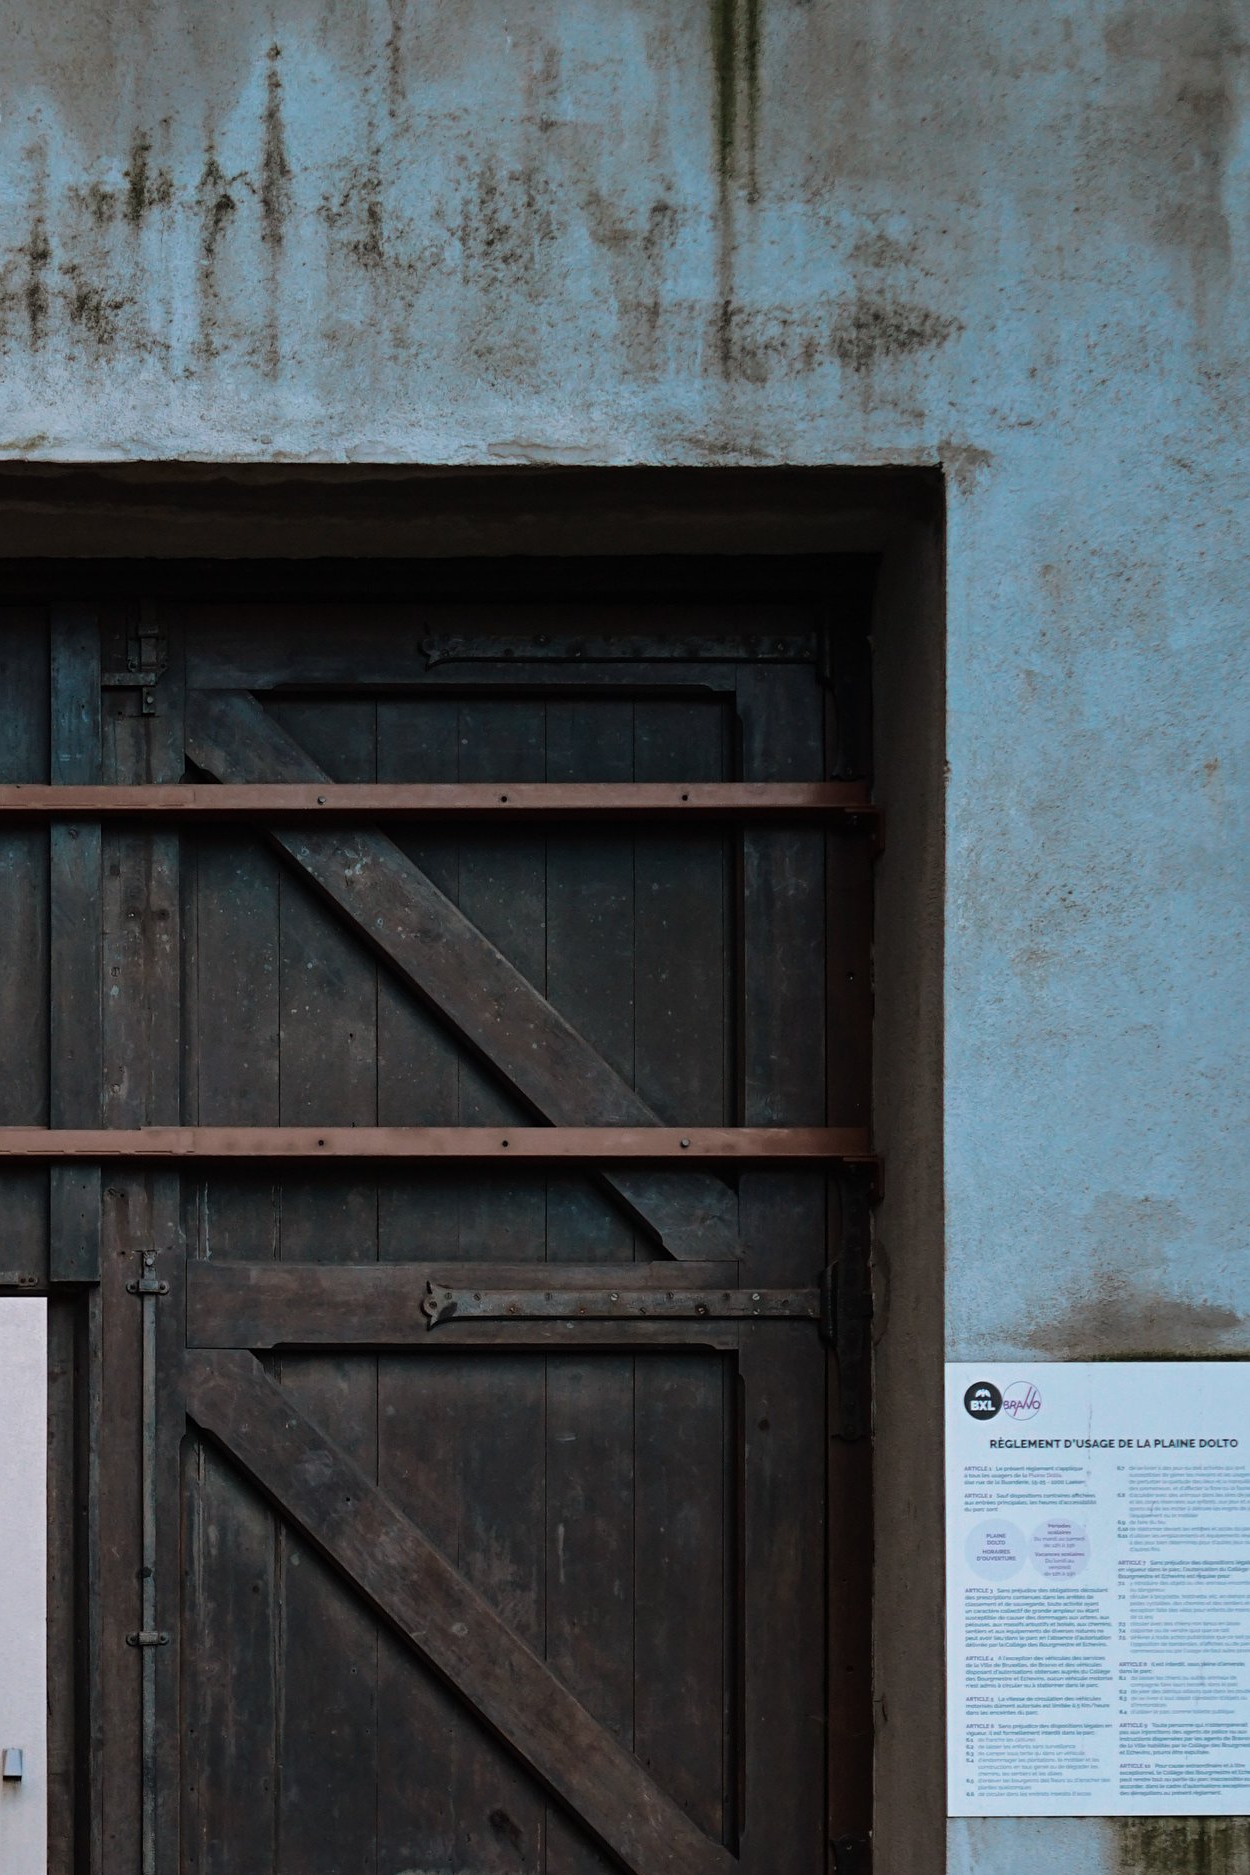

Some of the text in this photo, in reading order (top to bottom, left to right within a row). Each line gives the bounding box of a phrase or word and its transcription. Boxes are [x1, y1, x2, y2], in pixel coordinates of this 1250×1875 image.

[971, 1400, 996, 1411] BXL
[1064, 1439, 1115, 1449] D'USAGE
[1118, 1439, 1133, 1449] DE
[1137, 1439, 1151, 1449] LA
[1154, 1439, 1195, 1449] PLAINE
[1199, 1439, 1238, 1449] DOLTO
